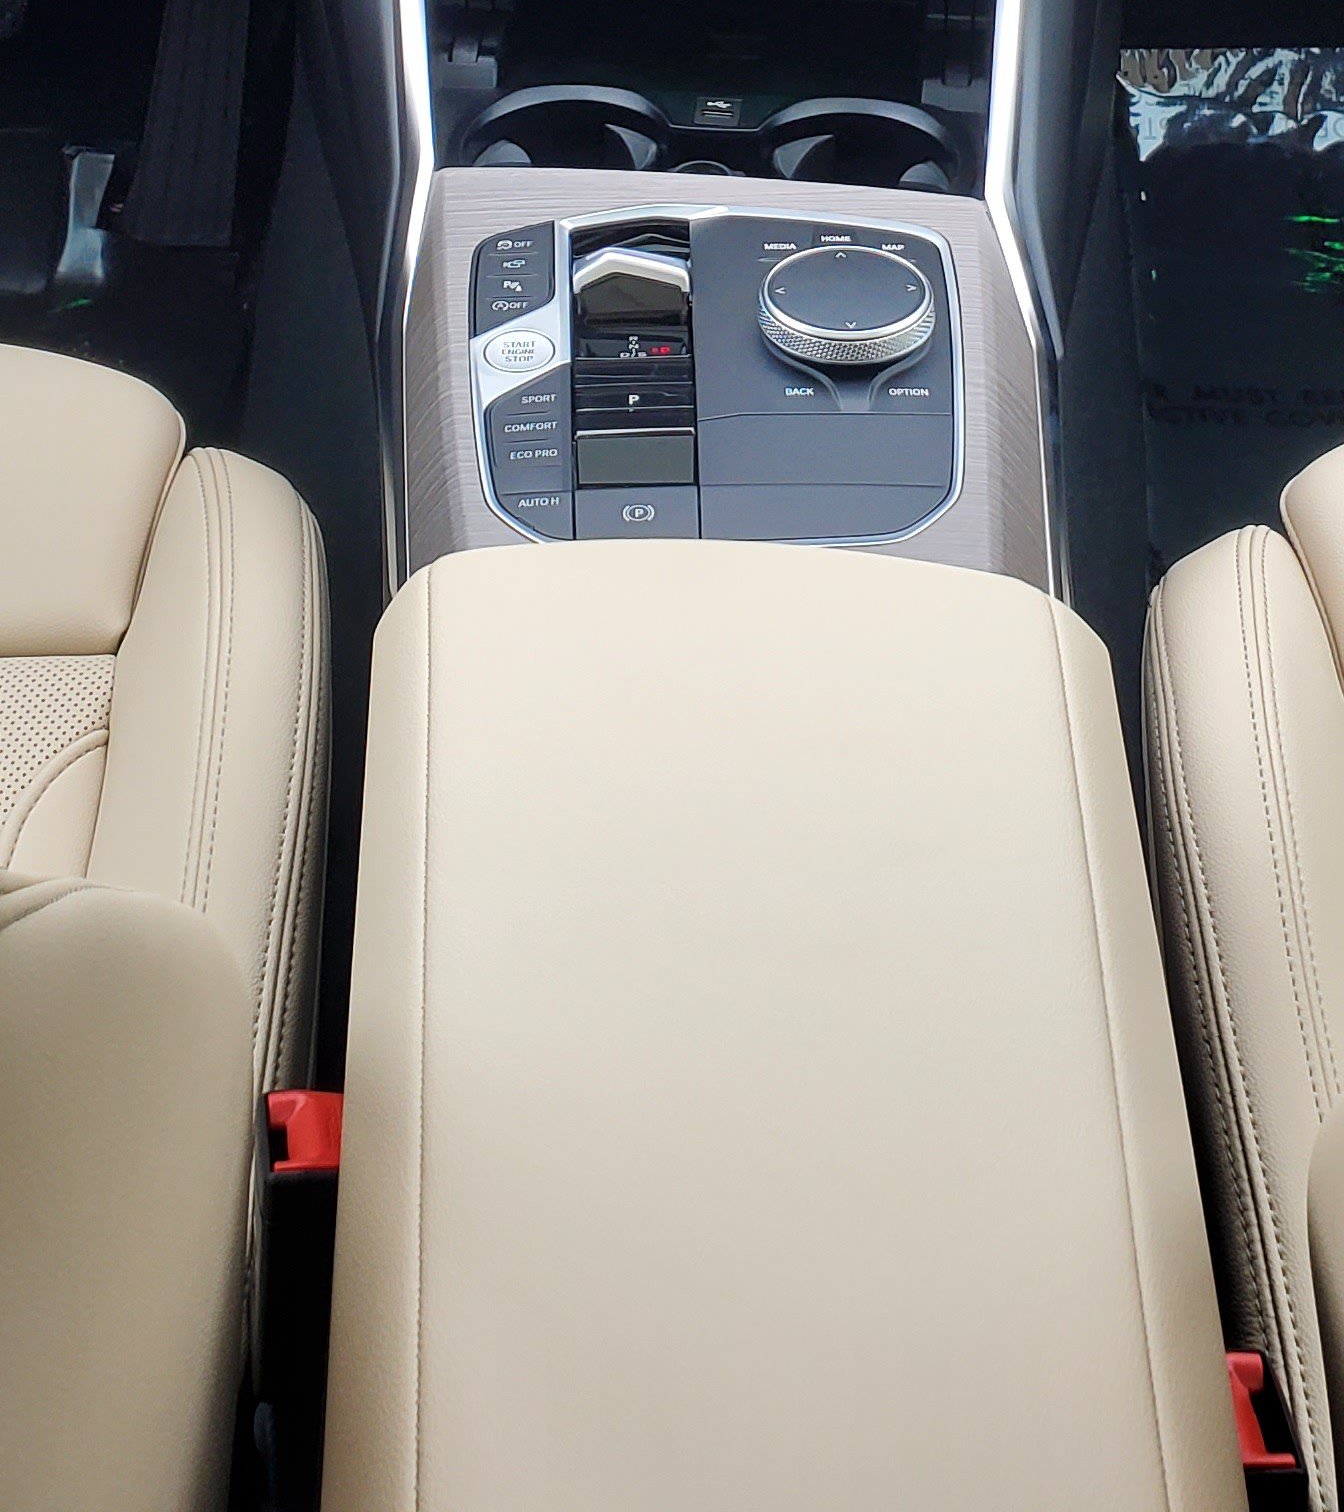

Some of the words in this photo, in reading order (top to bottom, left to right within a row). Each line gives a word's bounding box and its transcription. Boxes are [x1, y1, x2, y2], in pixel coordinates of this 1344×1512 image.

[513, 240, 534, 249] OFF
[505, 355, 534, 363] STOP
[785, 388, 814, 396] BACK
[888, 388, 929, 397] OPTION
[521, 393, 557, 405] SPORT
[628, 394, 640, 406] P
[504, 421, 558, 433] COMFORT
[509, 449, 532, 460] ECO
[534, 448, 558, 459] PRO
[518, 496, 549, 509] AUTO
[551, 496, 561, 506] H
